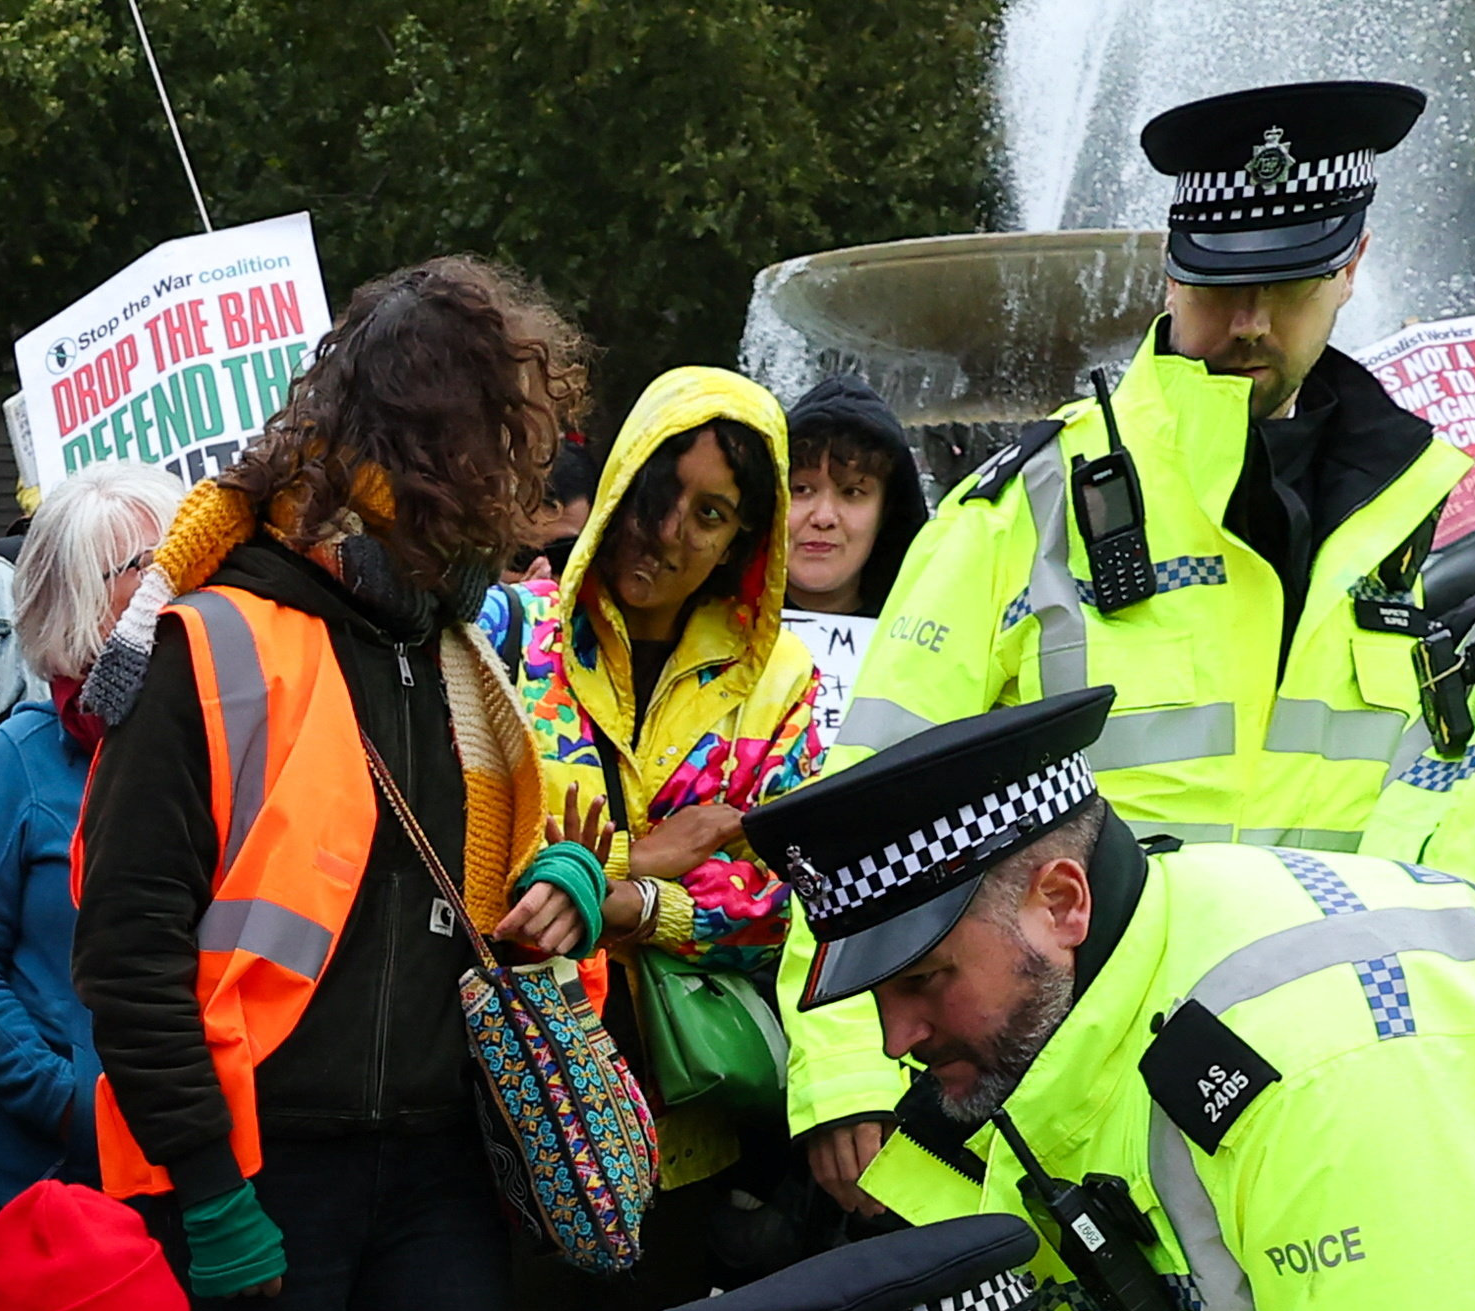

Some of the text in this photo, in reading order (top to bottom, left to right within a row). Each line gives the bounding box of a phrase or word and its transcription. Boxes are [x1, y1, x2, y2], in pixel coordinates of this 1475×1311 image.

[78, 255, 290, 351] Stop the War coalition
[51, 334, 139, 438] DROP
[144, 298, 214, 374] THE
[218, 280, 304, 350] BAN
[1357, 326, 1474, 367] Socialist Worker
[1402, 346, 1452, 382] NOT
[1391, 374, 1447, 412] IME
[62, 363, 224, 477] DEFEND
[890, 616, 950, 653] OLICE
[1198, 1065, 1227, 1098] AS
[1204, 1070, 1250, 1123] 2405
